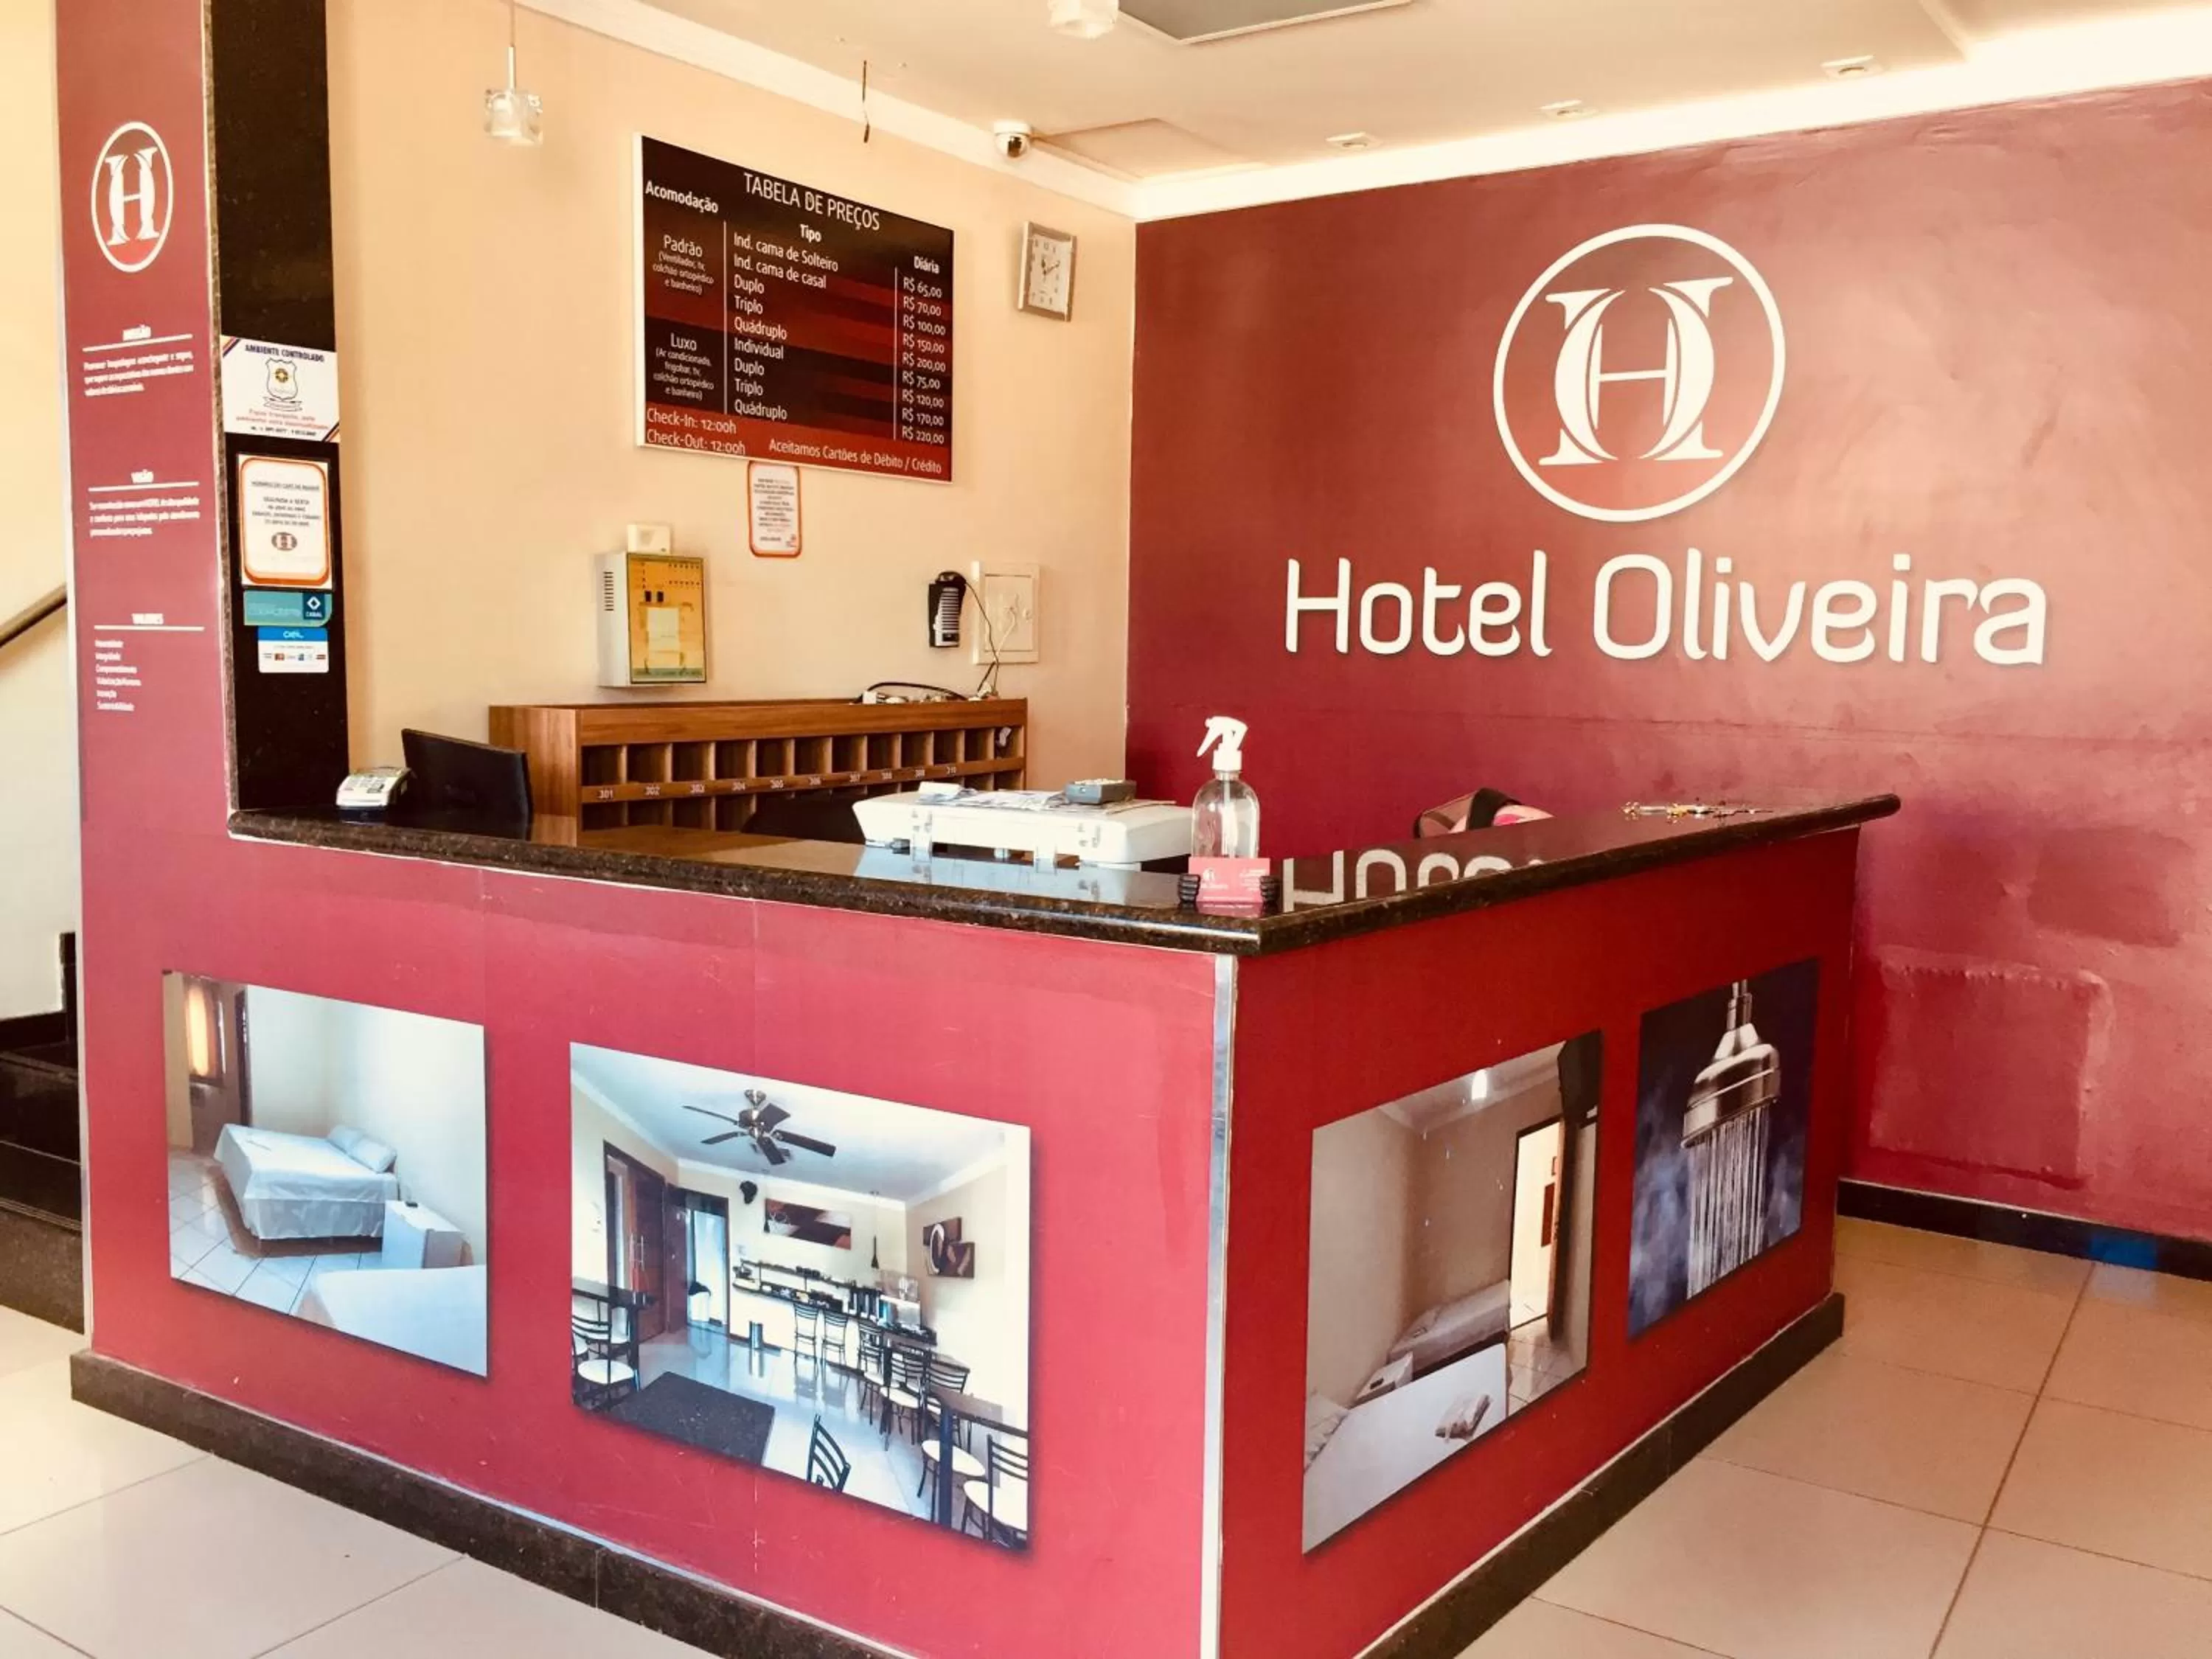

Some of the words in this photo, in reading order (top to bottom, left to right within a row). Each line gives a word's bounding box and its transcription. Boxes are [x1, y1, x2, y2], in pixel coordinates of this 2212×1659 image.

[645, 180, 719, 213] Acomodação
[744, 172, 801, 209] TABELA
[805, 191, 823, 215] DE
[828, 198, 880, 232] PREÇOS
[800, 223, 821, 243] Tipo
[664, 234, 703, 257] Padrão
[734, 232, 754, 250] Ind.
[756, 241, 784, 257] cama
[786, 246, 799, 262] de
[801, 250, 838, 271] Solteiro
[734, 253, 754, 271] Ind.
[756, 262, 784, 278] cama
[786, 266, 799, 282] de
[801, 274, 827, 289] casal
[914, 256, 939, 274] Diária
[734, 274, 765, 294] Duplo
[903, 277, 915, 293] R$
[917, 281, 942, 299] 65,00
[734, 295, 763, 315] Triplo
[903, 296, 915, 311] R$
[917, 302, 942, 316] 70,00
[734, 316, 787, 341] Quádruplo
[903, 314, 915, 330] R$
[917, 321, 946, 335] 100,00
[670, 332, 697, 351] Luxo
[734, 337, 784, 359] Individual
[903, 333, 915, 349] R$
[917, 339, 945, 353] 150,00
[245, 344, 279, 357] AMBIENTE
[282, 349, 325, 363] CONTROLADO
[902, 352, 914, 366] R$
[734, 358, 765, 376] Duplo
[734, 378, 763, 397] Triplo
[902, 370, 914, 386] R$
[917, 375, 941, 389] 75,00
[902, 389, 914, 404] R$
[917, 394, 944, 408] 120,00
[734, 399, 787, 421] Quádruplo
[902, 407, 914, 422] R$
[917, 413, 944, 427] 170,00
[647, 408, 698, 428] Check-In:
[701, 419, 737, 434] 12:00h
[647, 428, 709, 449] Check-Out:
[712, 440, 745, 456] 12:00h
[902, 425, 914, 440] R$
[917, 430, 944, 445] 220,00
[769, 439, 821, 458] Aceitamos
[822, 445, 858, 464] Cartões
[860, 449, 872, 465] de
[874, 453, 903, 470] Débito
[911, 458, 942, 474] Crédito
[1284, 549, 1554, 658] Hotel
[1592, 546, 2048, 667] Oliveira
[599, 789, 614, 800] 301
[645, 785, 661, 796] 302
[689, 784, 706, 794] 303
[731, 782, 745, 791] 304
